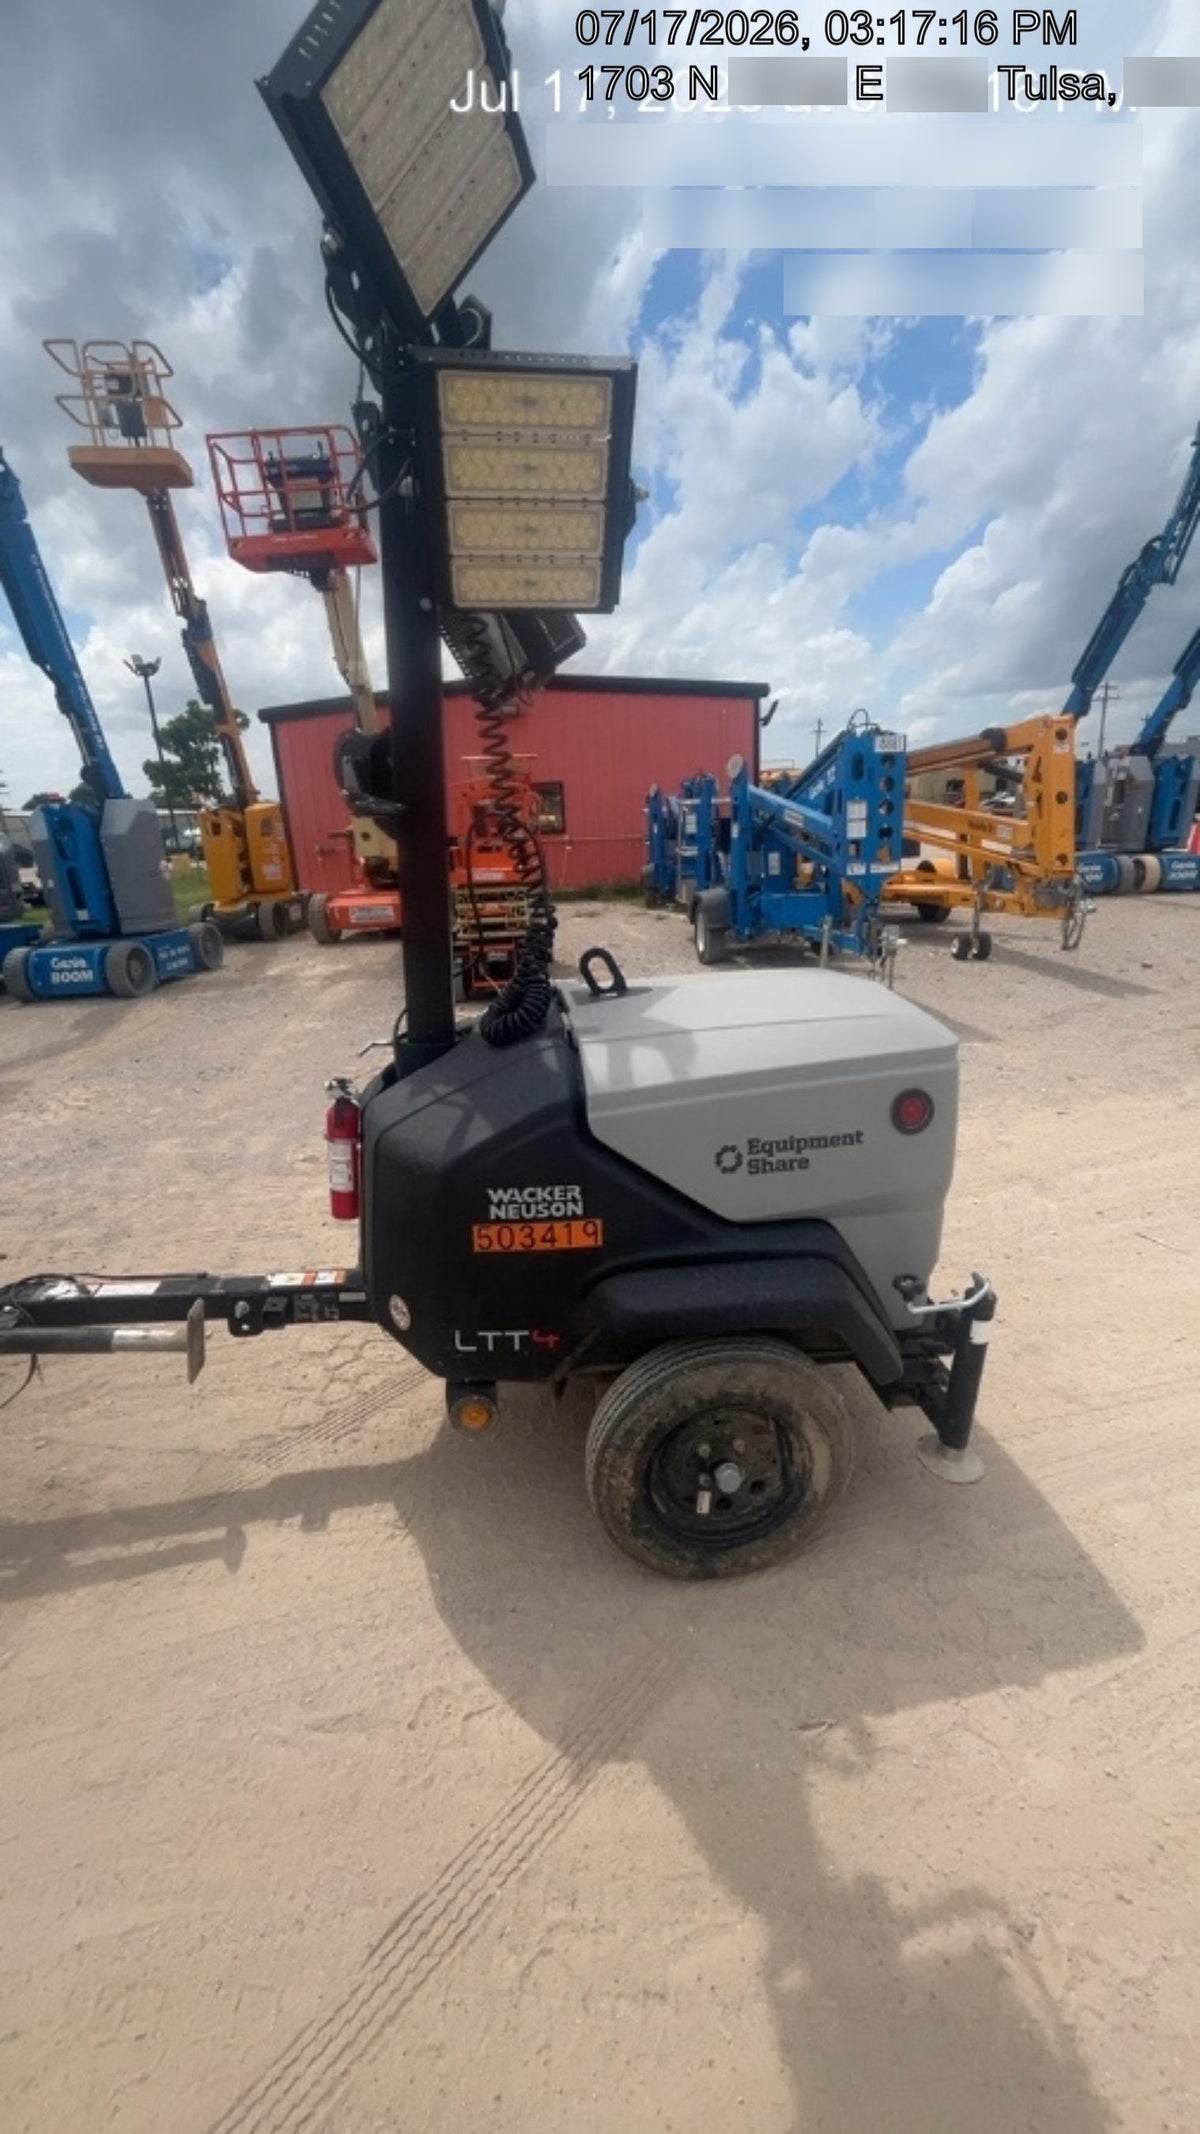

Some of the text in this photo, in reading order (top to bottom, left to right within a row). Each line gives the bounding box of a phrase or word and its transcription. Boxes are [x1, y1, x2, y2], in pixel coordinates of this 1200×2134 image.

[51, 969, 93, 985] BOOM
[746, 1130, 865, 1157] Equipment
[746, 1156, 810, 1175] Share
[486, 1185, 582, 1203] WACKER
[489, 1201, 584, 1219] NEUSON
[477, 1220, 600, 1251] 503419
[454, 1329, 560, 1352] LTT4
